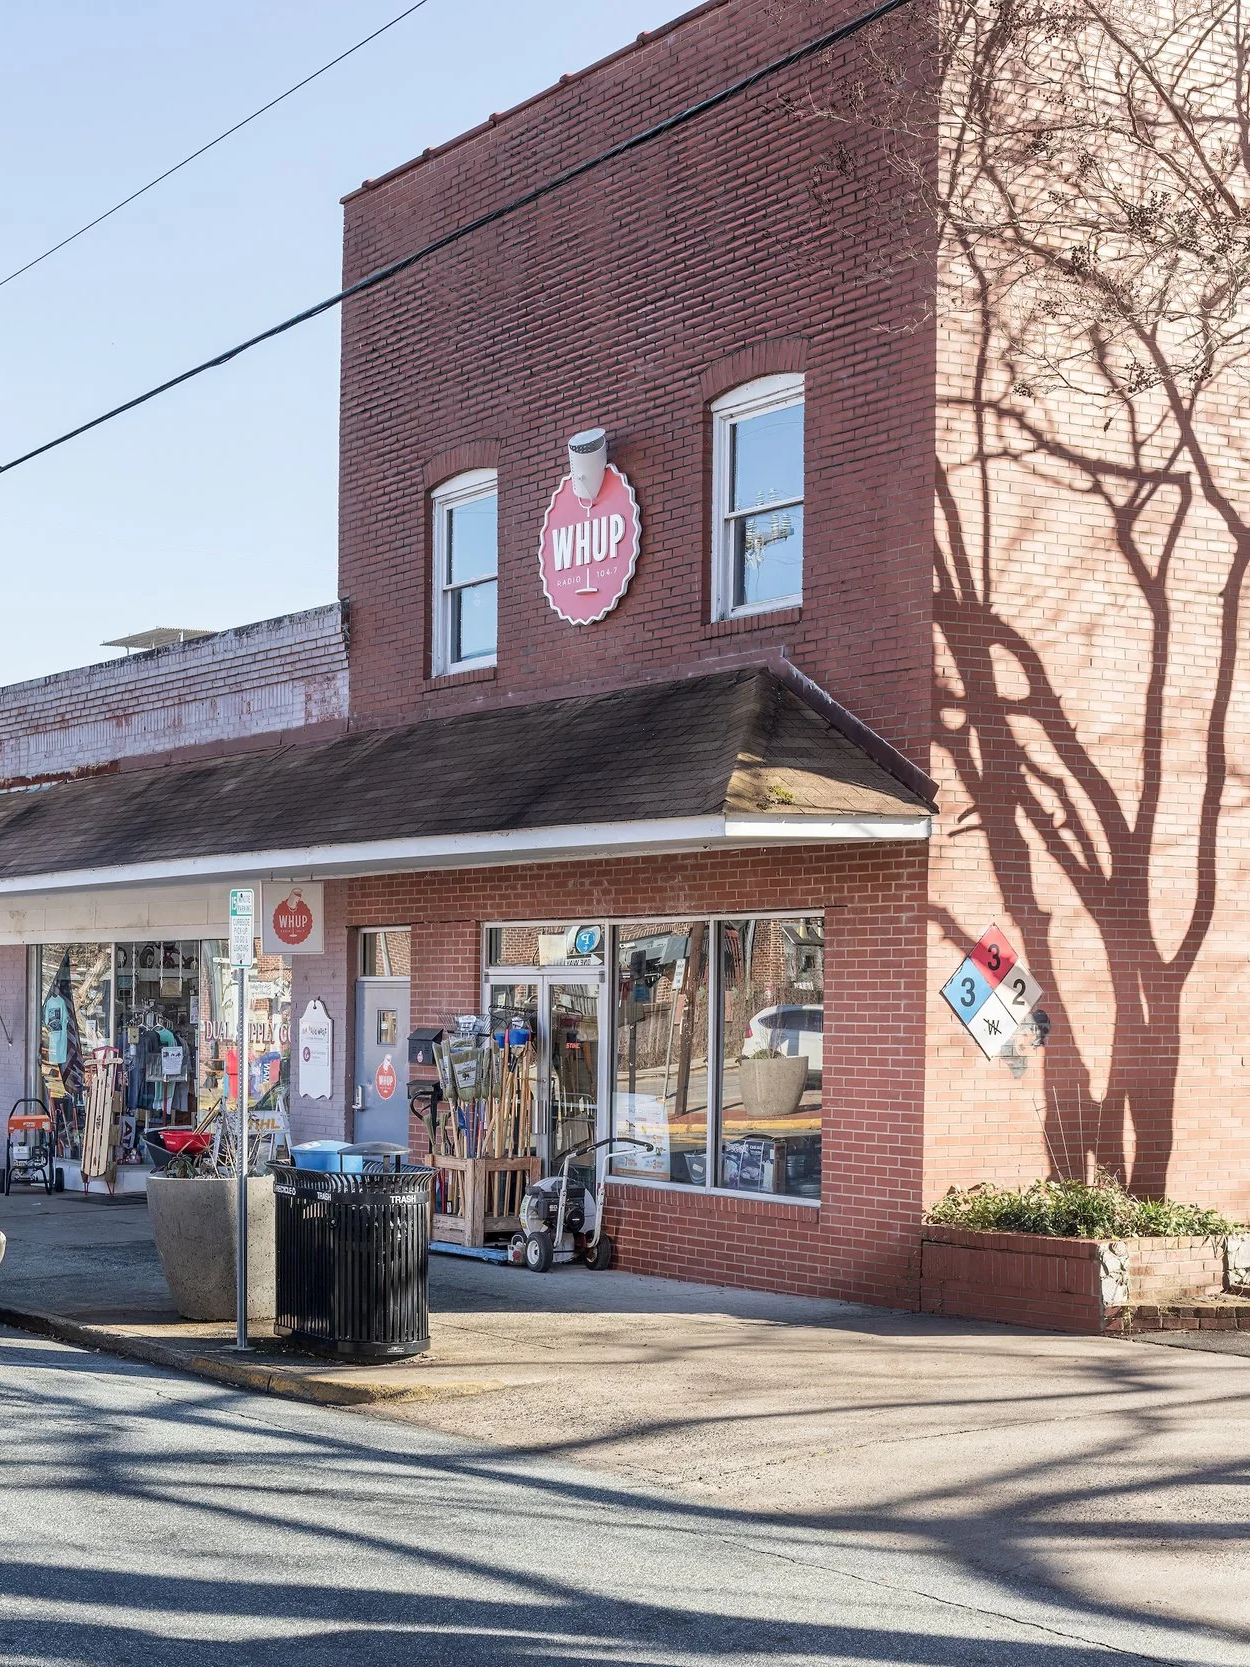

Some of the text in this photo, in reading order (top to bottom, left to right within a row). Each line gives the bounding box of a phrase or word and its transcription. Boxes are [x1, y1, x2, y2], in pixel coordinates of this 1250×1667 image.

[552, 514, 625, 571] WHUP
[596, 567, 618, 578] 104.7
[557, 576, 581, 587] RADIO
[278, 914, 308, 928] WHUP
[988, 944, 1001, 971] 3
[960, 977, 976, 1007] 3
[1012, 978, 1026, 1006] 2
[205, 1020, 233, 1042] DUAL
[237, 1022, 276, 1045] PPLY
[378, 1075, 393, 1085] WHUP
[276, 1185, 293, 1194] RECYCLE
[317, 1191, 331, 1201] TRASH
[390, 1195, 417, 1203] TRASH
